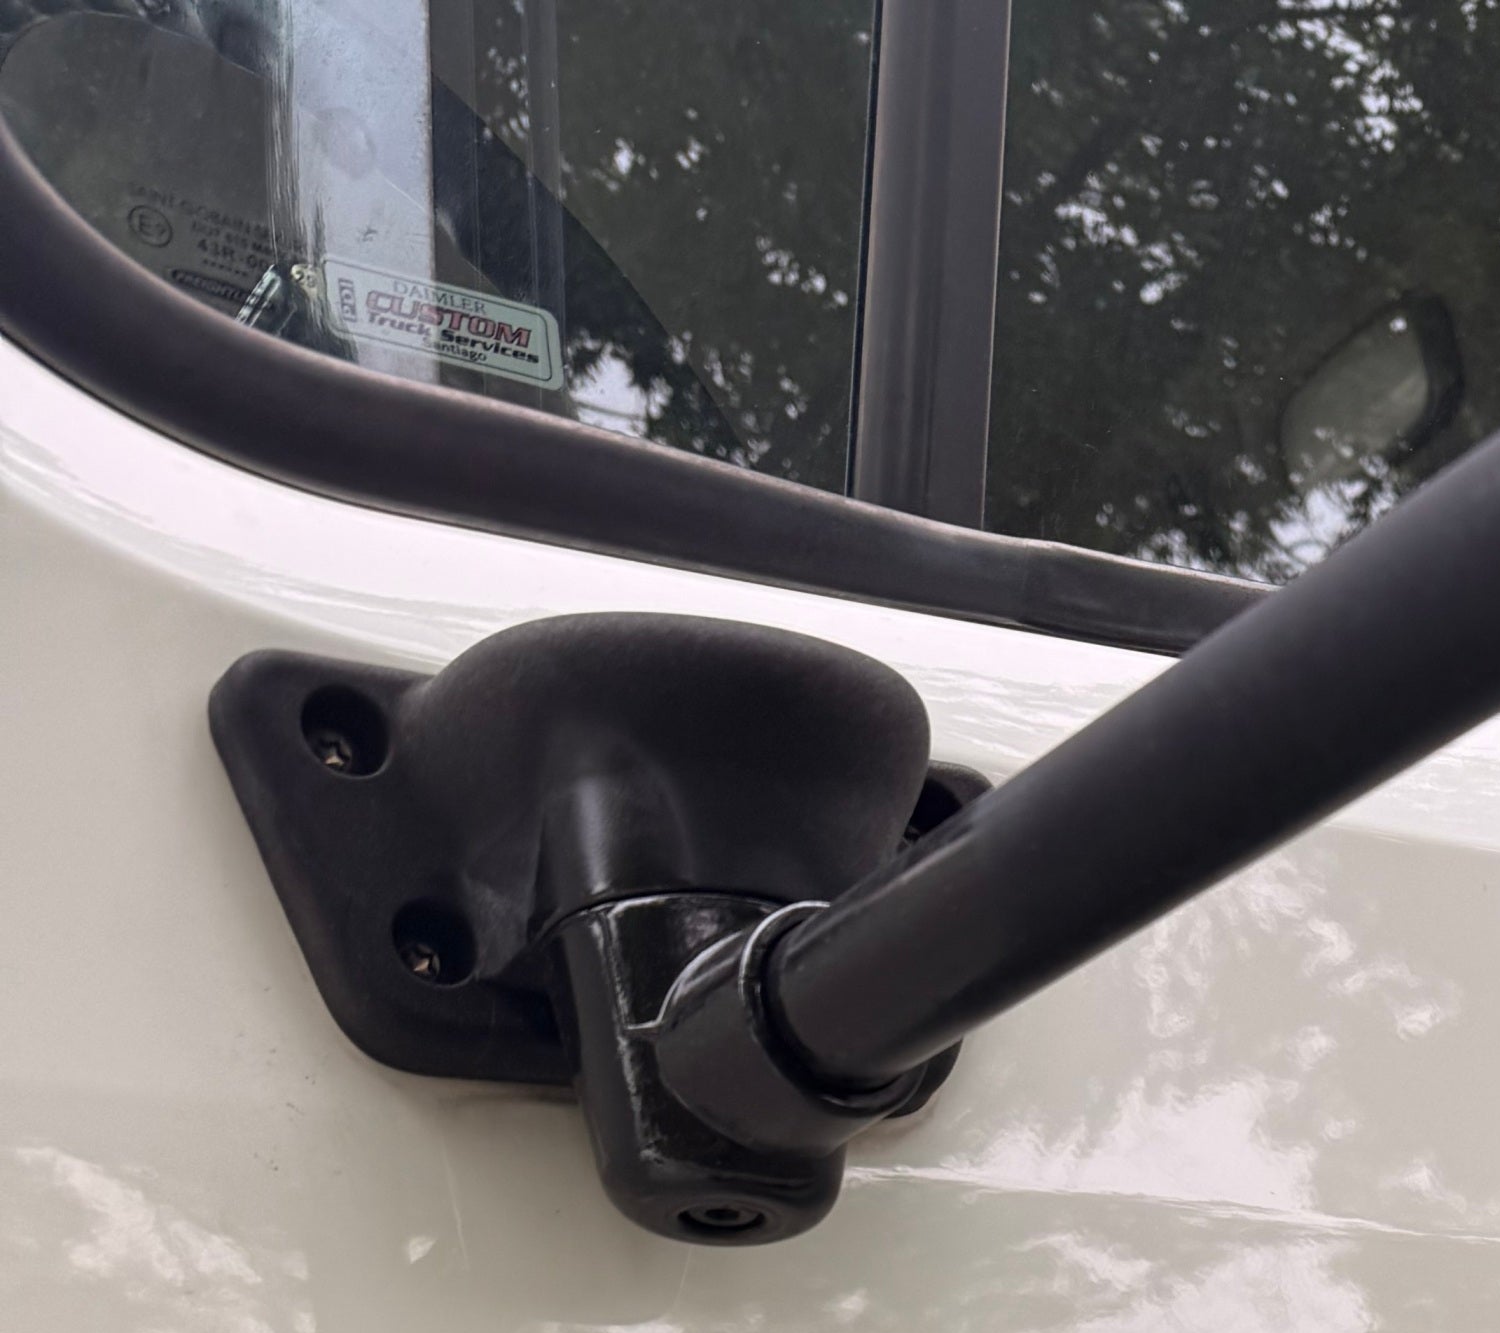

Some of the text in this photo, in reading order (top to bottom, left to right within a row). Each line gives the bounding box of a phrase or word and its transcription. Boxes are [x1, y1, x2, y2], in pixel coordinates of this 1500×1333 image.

[366, 290, 532, 348] CUSTOM
[393, 280, 487, 315] DAIMLER
[368, 311, 540, 364] Truck Services
[422, 336, 487, 362] Santiago
